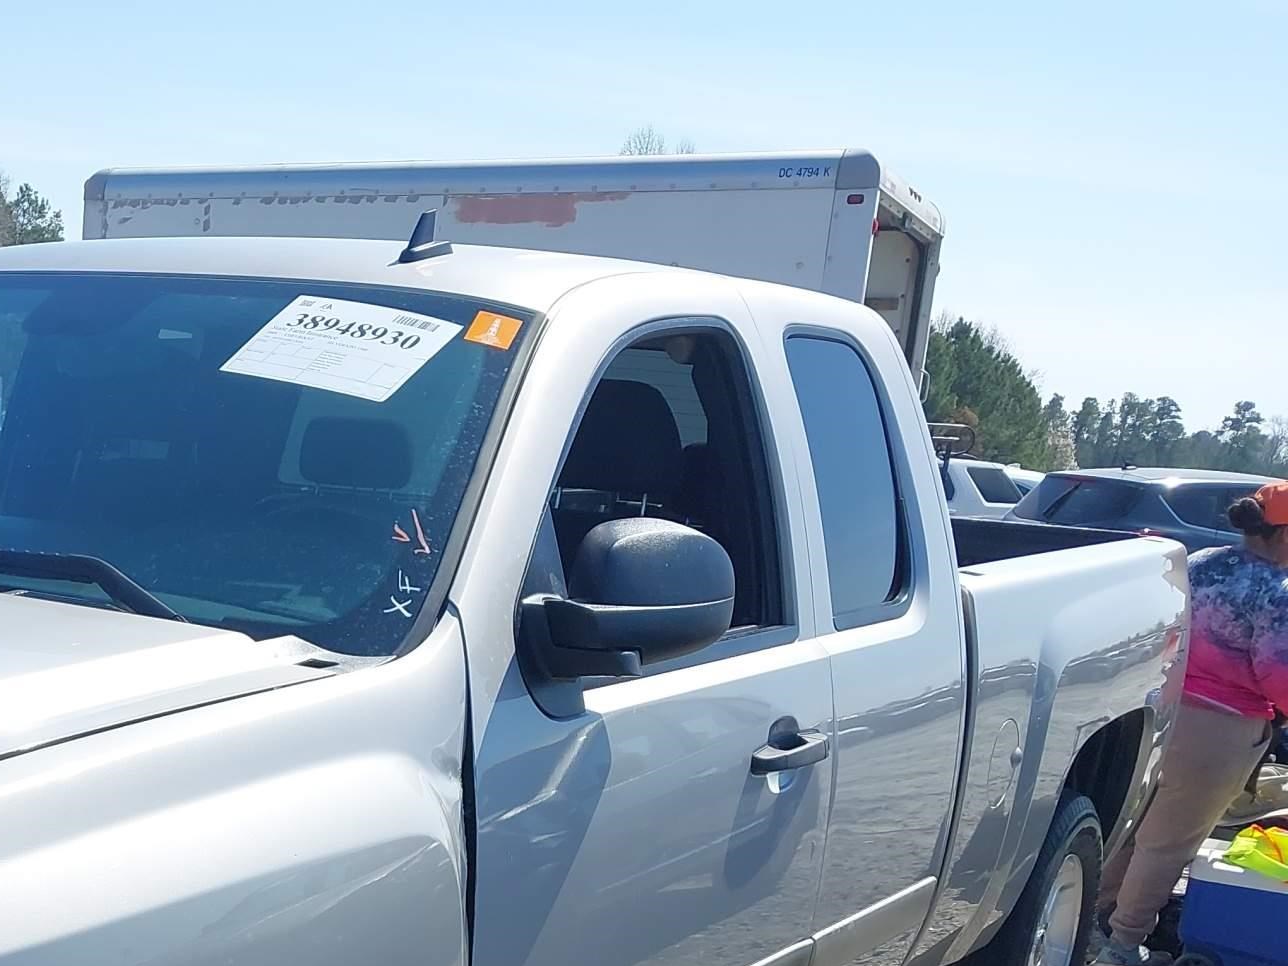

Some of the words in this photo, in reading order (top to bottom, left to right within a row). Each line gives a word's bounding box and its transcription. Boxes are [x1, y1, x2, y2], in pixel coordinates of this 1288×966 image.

[779, 167, 793, 178] DC
[796, 167, 819, 178] 4794
[823, 167, 831, 177] K
[286, 312, 421, 350] 38948930
